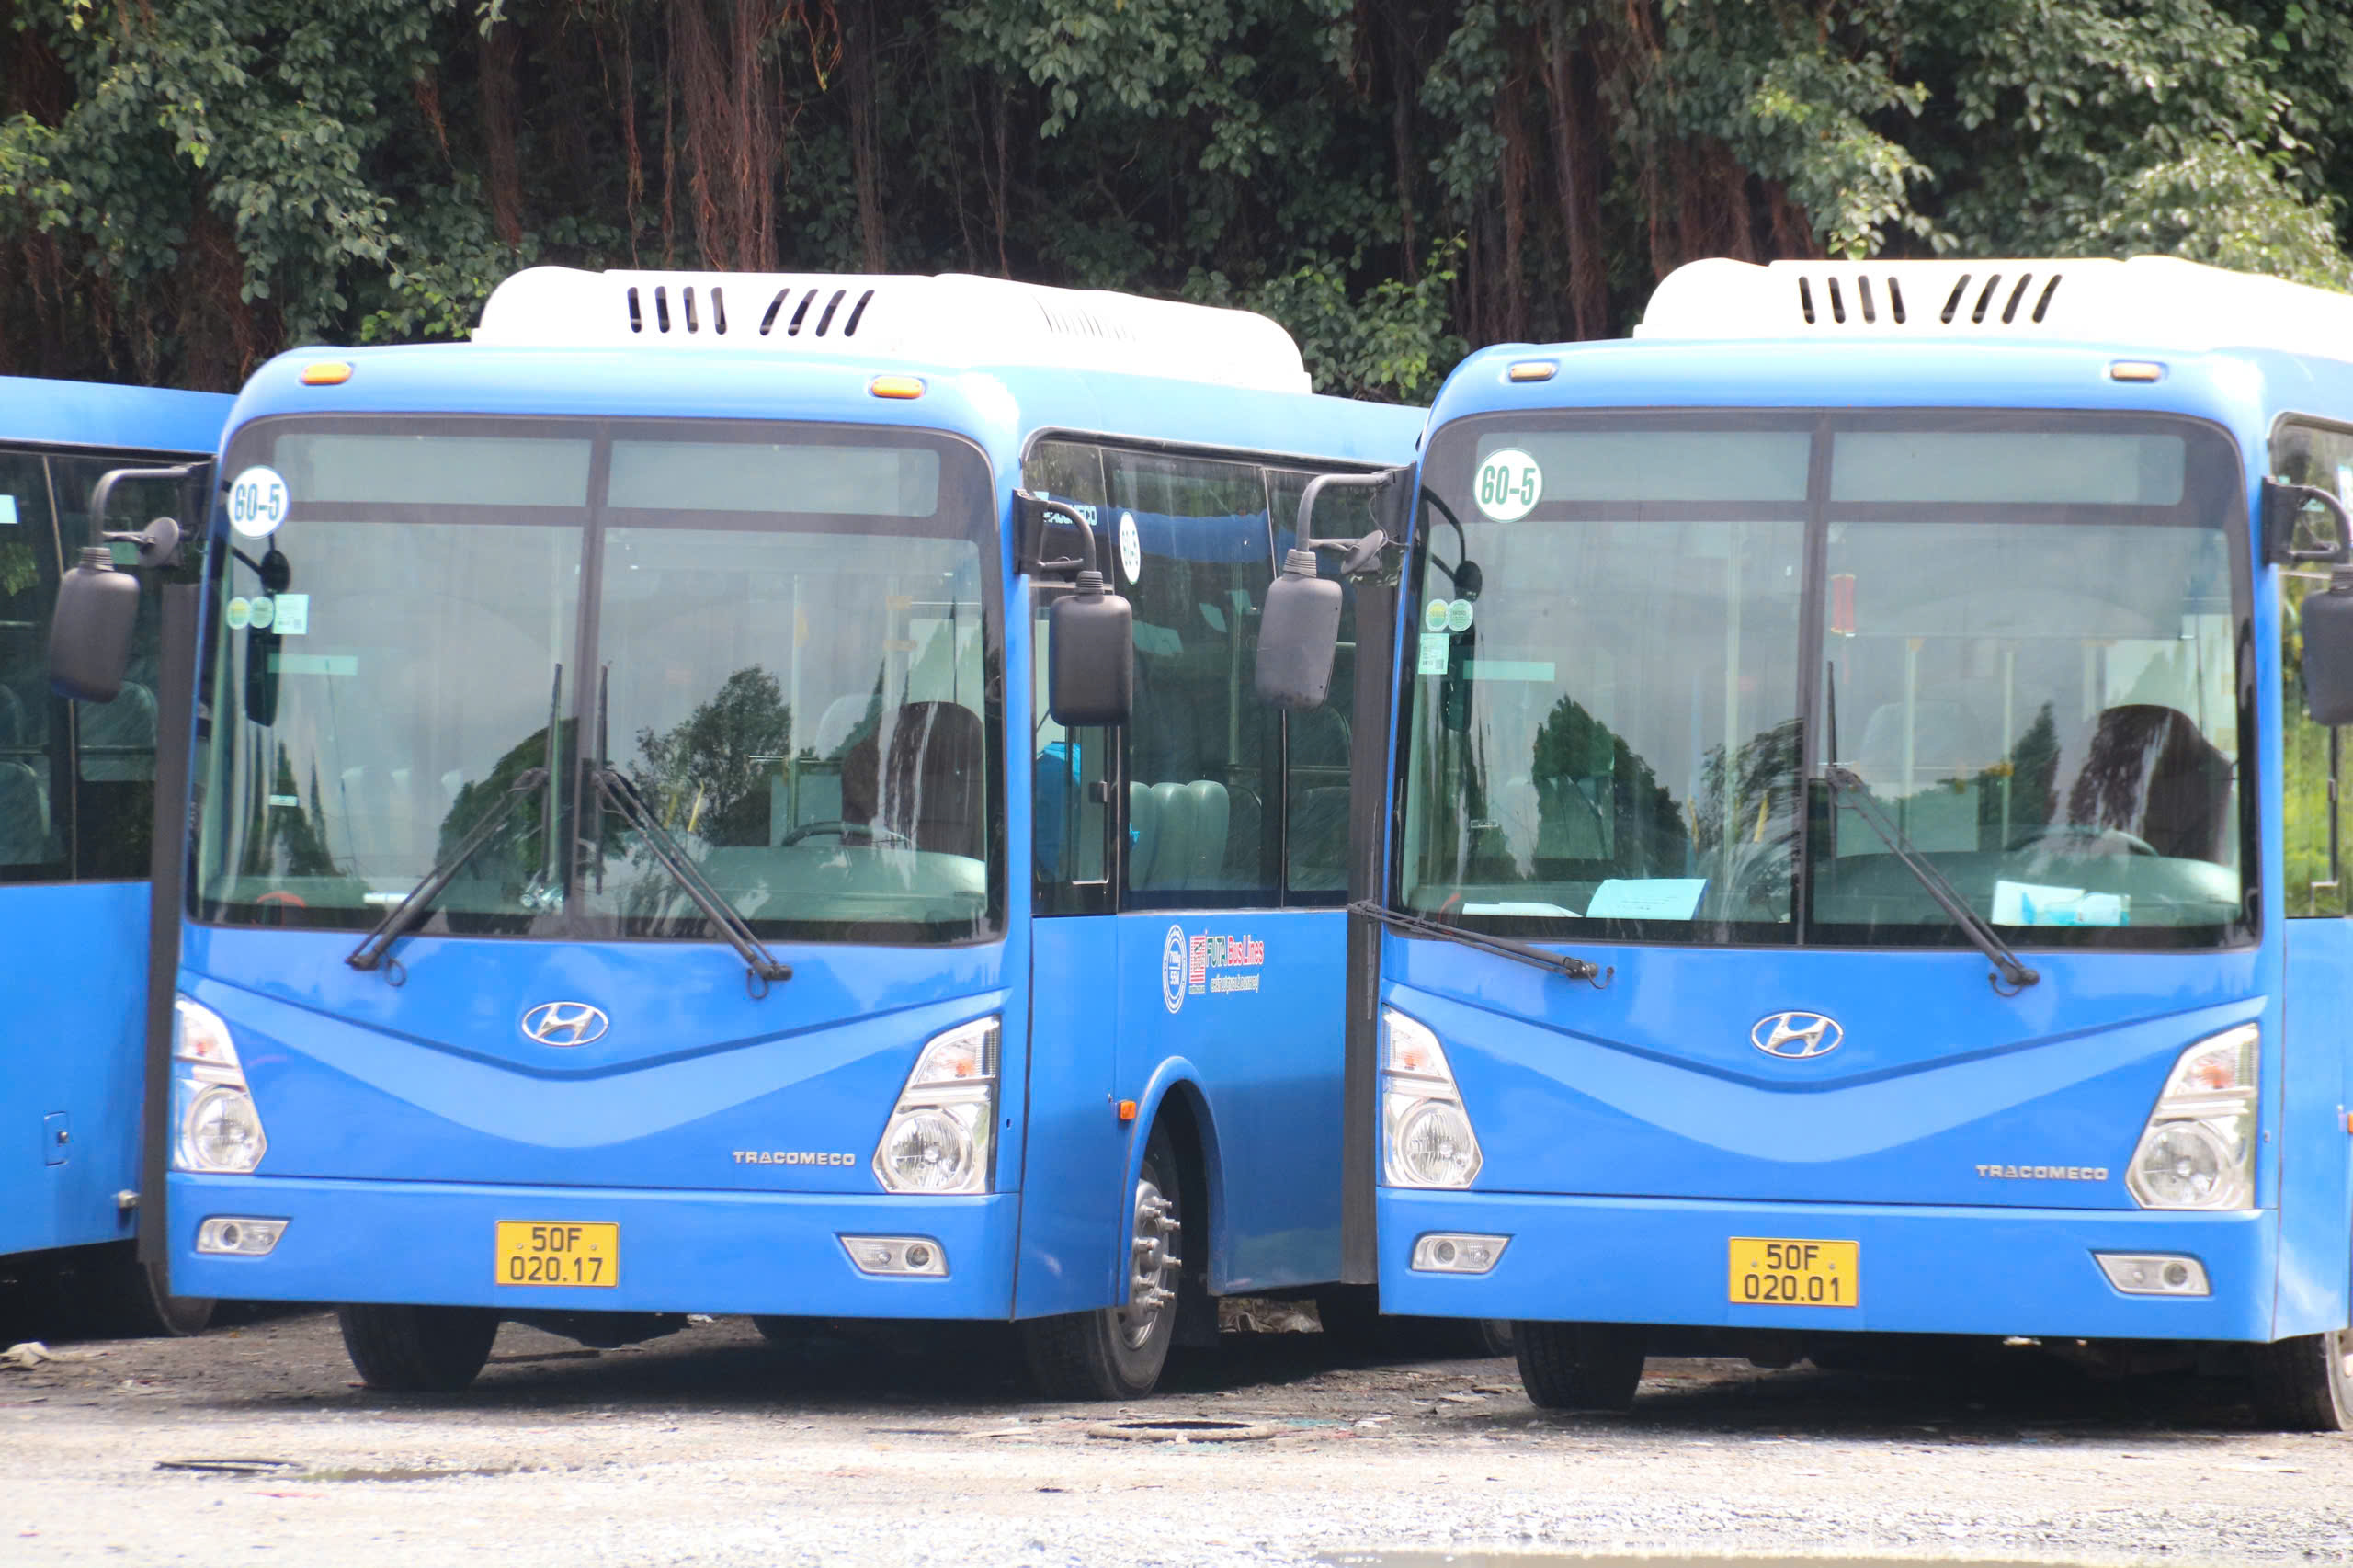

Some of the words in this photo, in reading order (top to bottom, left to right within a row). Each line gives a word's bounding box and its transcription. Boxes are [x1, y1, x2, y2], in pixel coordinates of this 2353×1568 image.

[1481, 465, 1536, 506] 60-5
[234, 483, 280, 522] 60-5
[1205, 936, 1227, 968] FUTA
[733, 1151, 856, 1166] TRACOMECO
[1975, 1165, 2109, 1181] TRACOMECO
[532, 1226, 583, 1252] 50F
[510, 1256, 603, 1282] 020.17
[1766, 1244, 1820, 1270] 50F
[1744, 1273, 1839, 1301] 020.01
